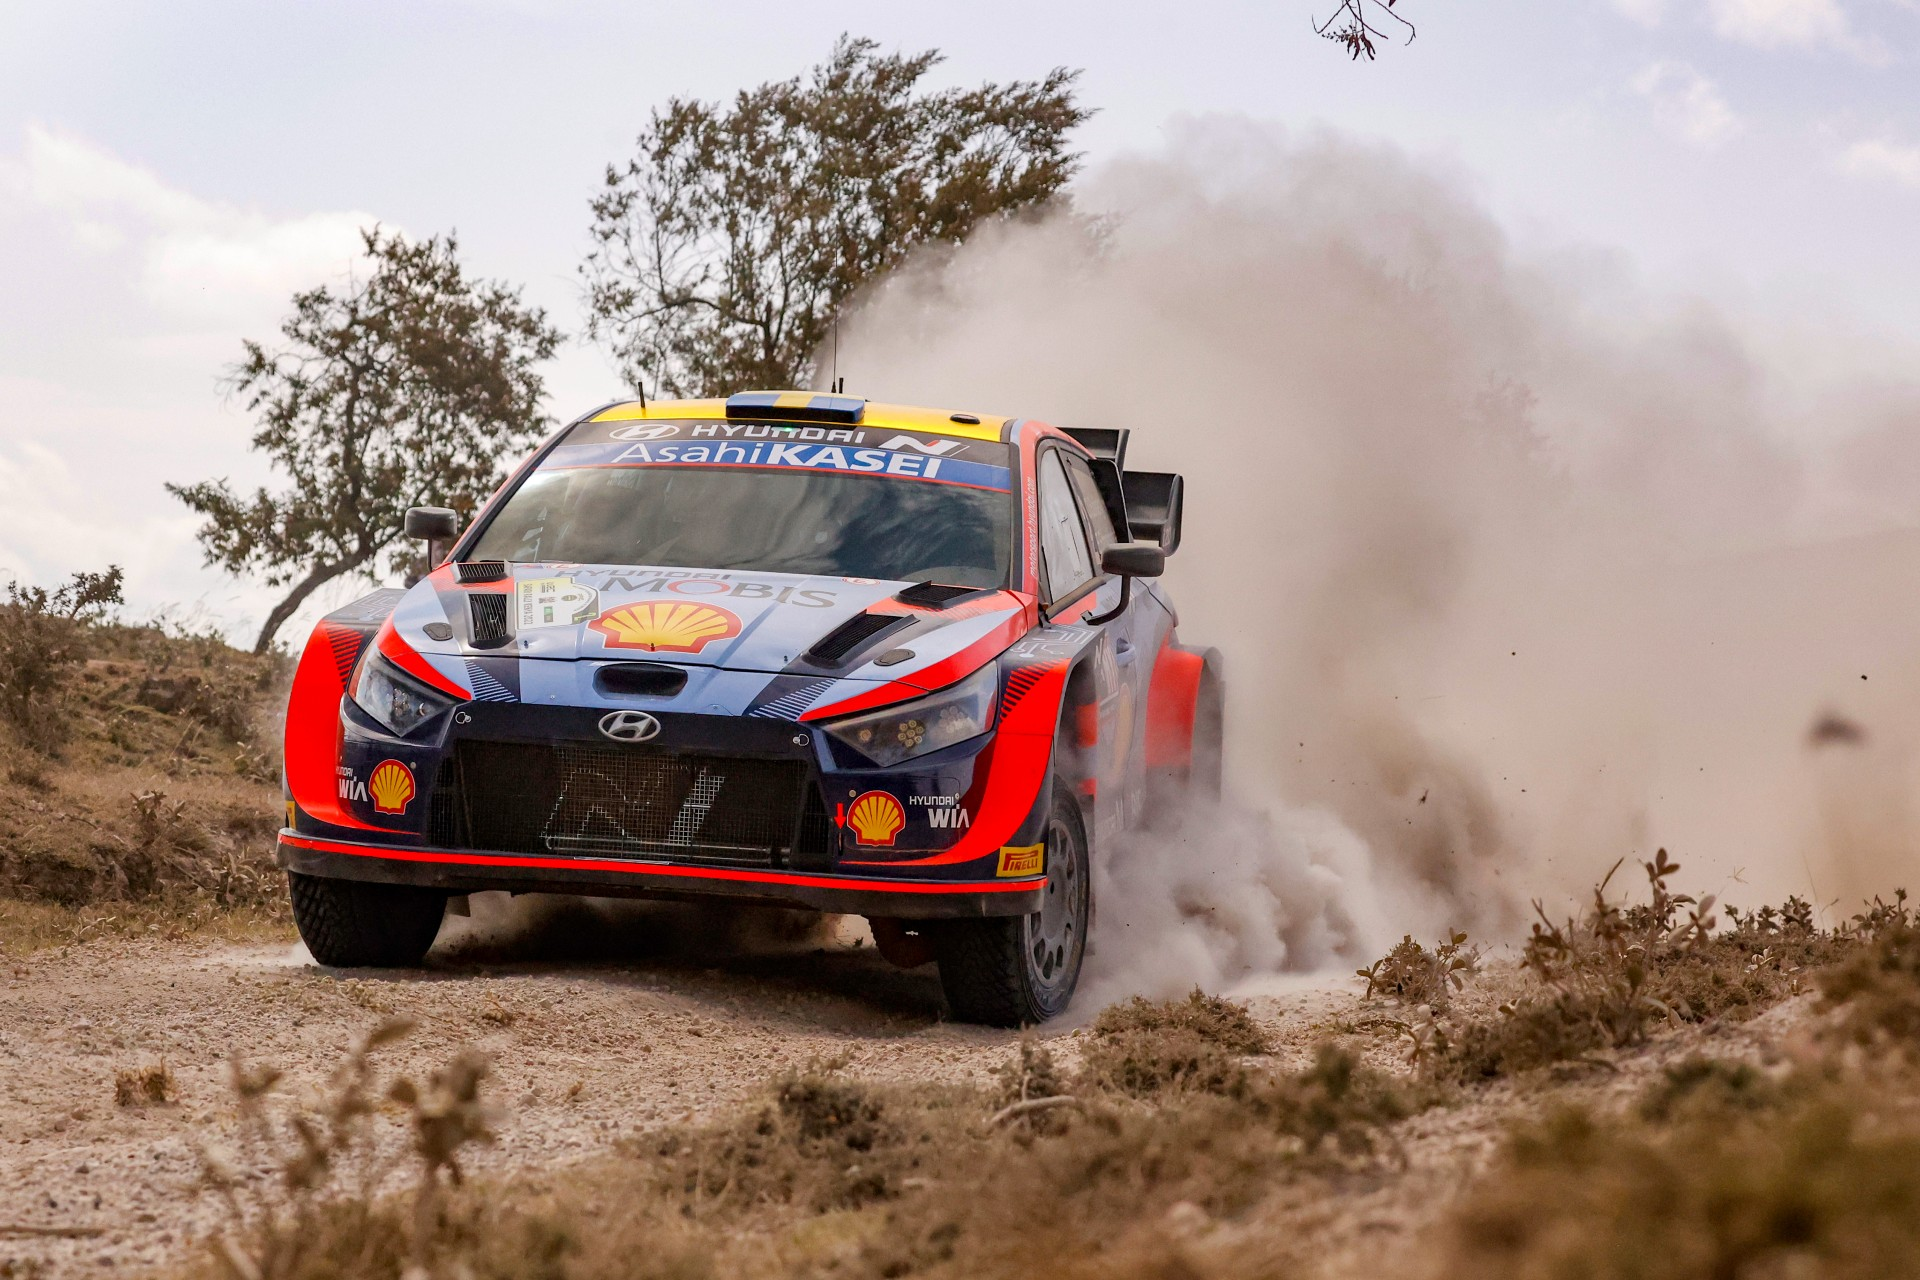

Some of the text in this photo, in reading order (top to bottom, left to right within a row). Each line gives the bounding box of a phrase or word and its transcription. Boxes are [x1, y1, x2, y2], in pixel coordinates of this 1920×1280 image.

[690, 424, 866, 444] HYUNDAI
[554, 569, 732, 580] HYUNDAI
[599, 576, 838, 608] MOBIS
[909, 795, 955, 806] HYUNDAI
[1002, 849, 1039, 872] PIRELLI
